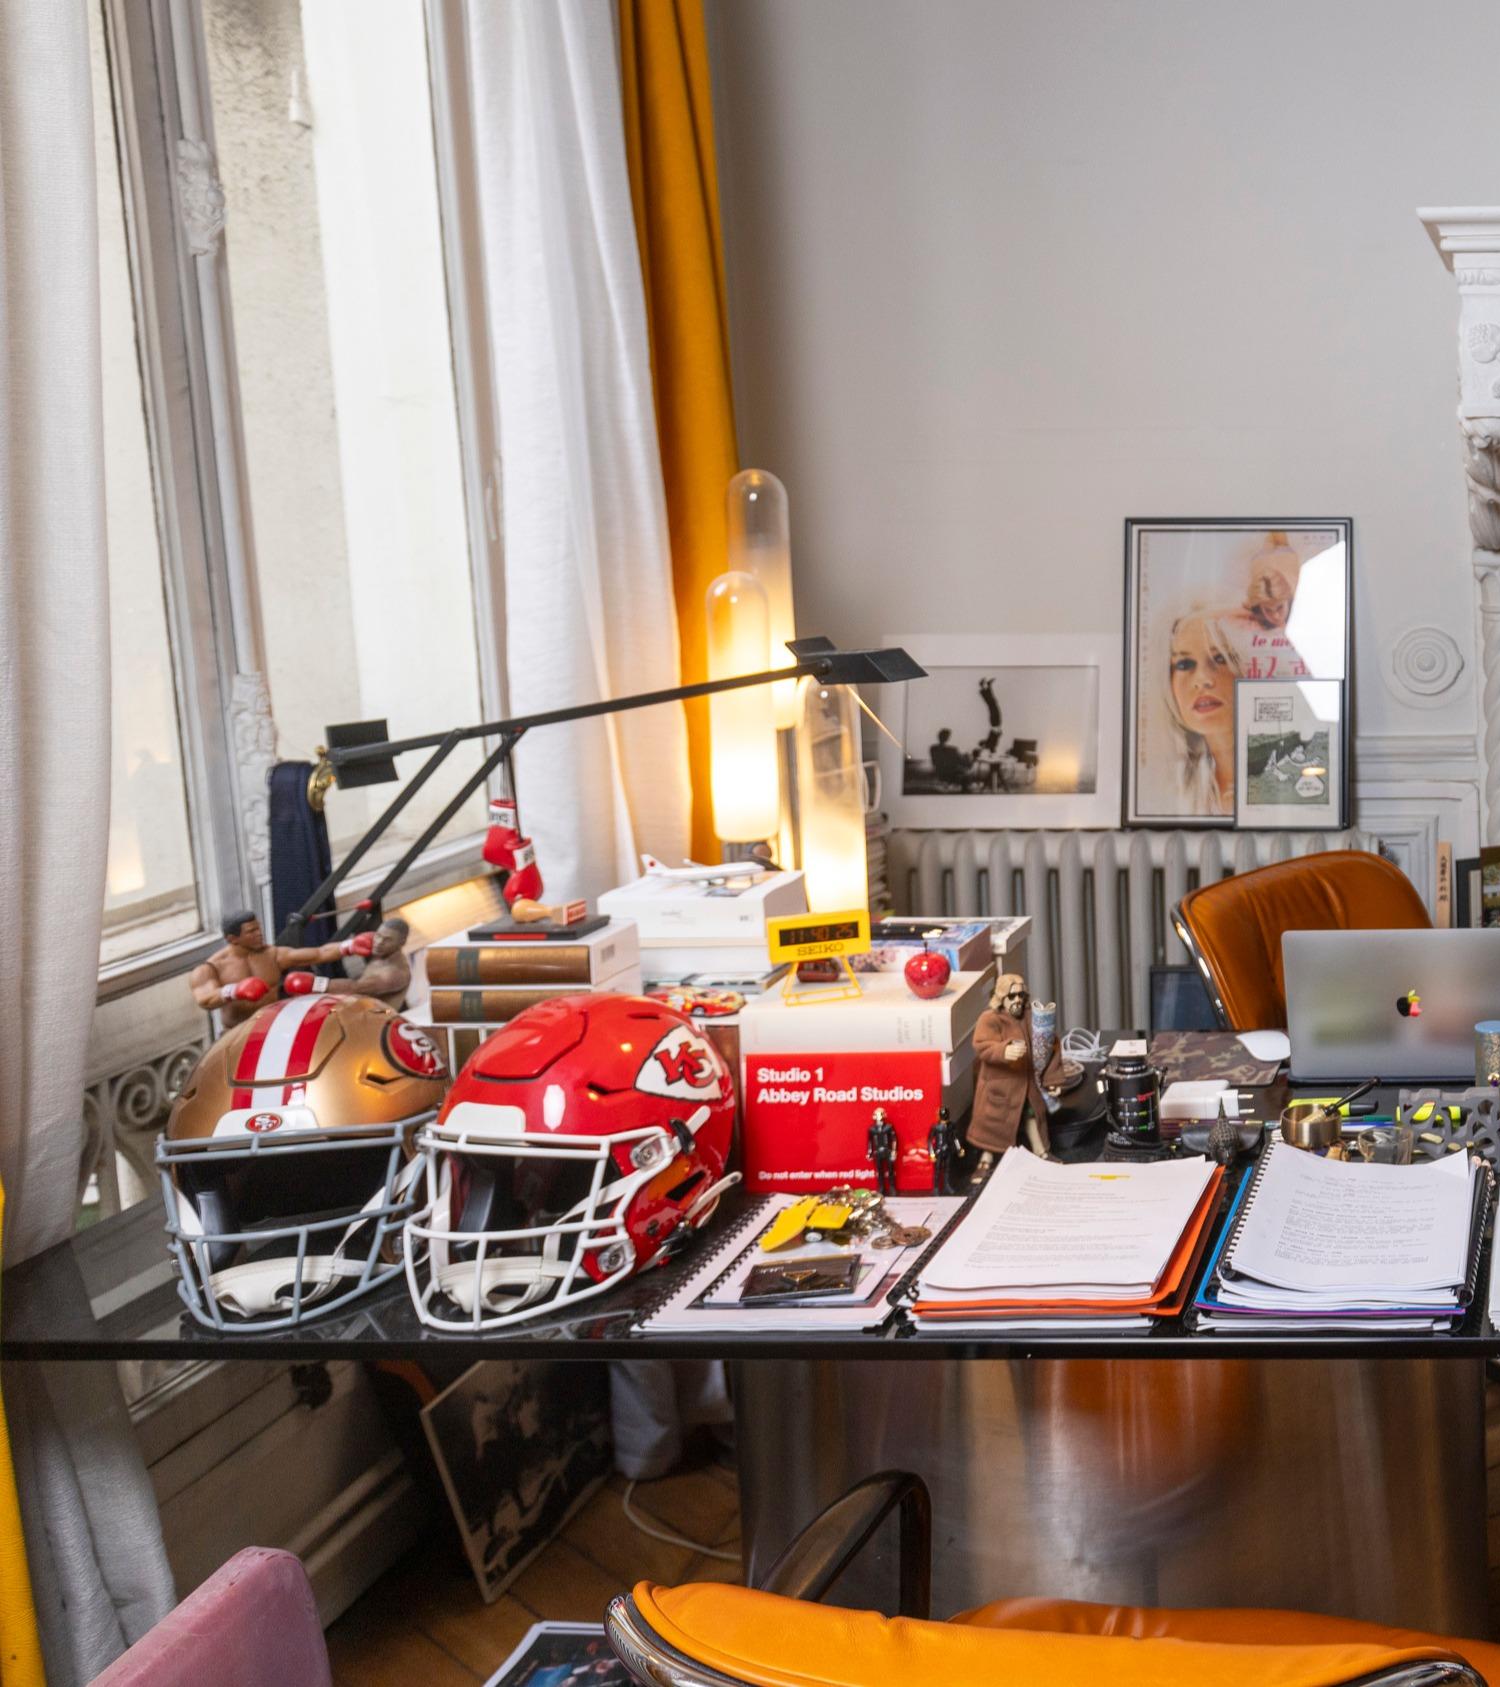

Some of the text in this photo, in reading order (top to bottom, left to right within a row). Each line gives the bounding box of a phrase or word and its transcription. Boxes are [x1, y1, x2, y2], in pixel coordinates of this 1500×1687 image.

[797, 943, 844, 956] SEIKO
[757, 1066, 824, 1083] Studio 1
[757, 1085, 924, 1106] Abbey Road Studios
[758, 1170, 773, 1180] Do
[773, 1170, 789, 1179] not
[789, 1170, 813, 1180] enter
[813, 1169, 838, 1179] when
[839, 1169, 854, 1179] red
[854, 1168, 875, 1180] light
